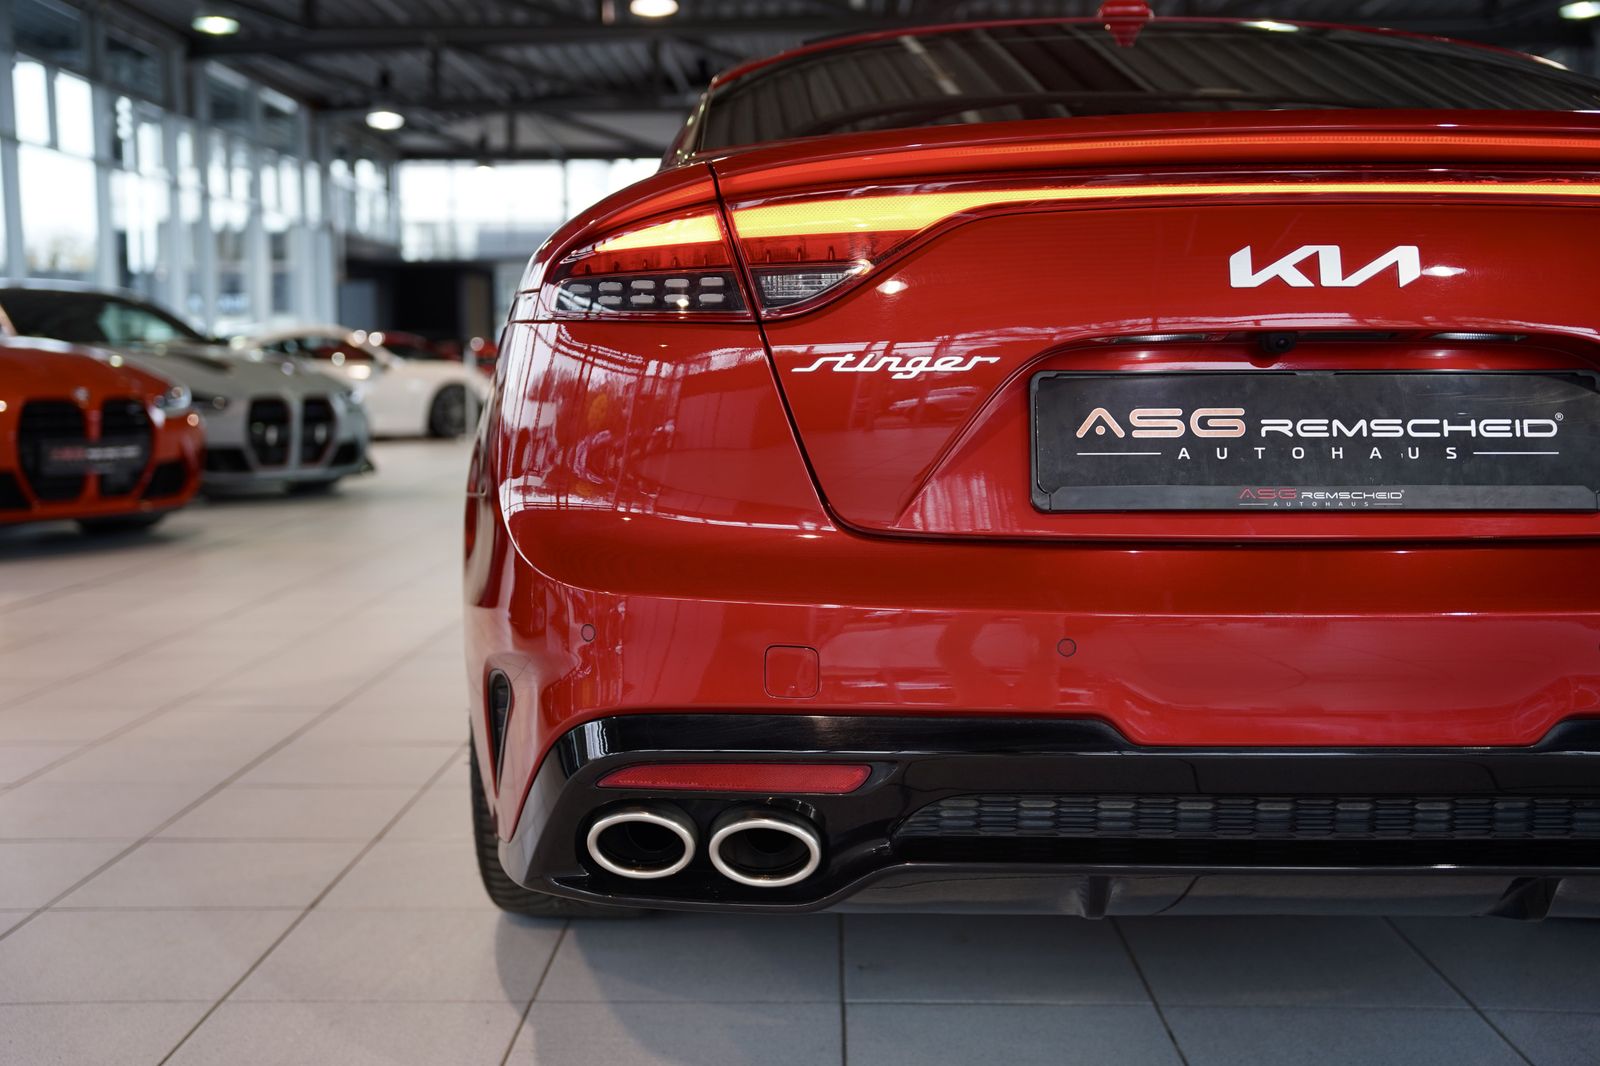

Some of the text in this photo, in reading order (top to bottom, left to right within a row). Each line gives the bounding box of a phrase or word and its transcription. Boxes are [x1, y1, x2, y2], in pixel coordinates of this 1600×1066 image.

[1229, 245, 1421, 288] KIA
[1075, 407, 1246, 439] ASG
[1177, 447, 1457, 460] AUTOHAUS
[1239, 488, 1405, 500] ASG REMSCHEID
